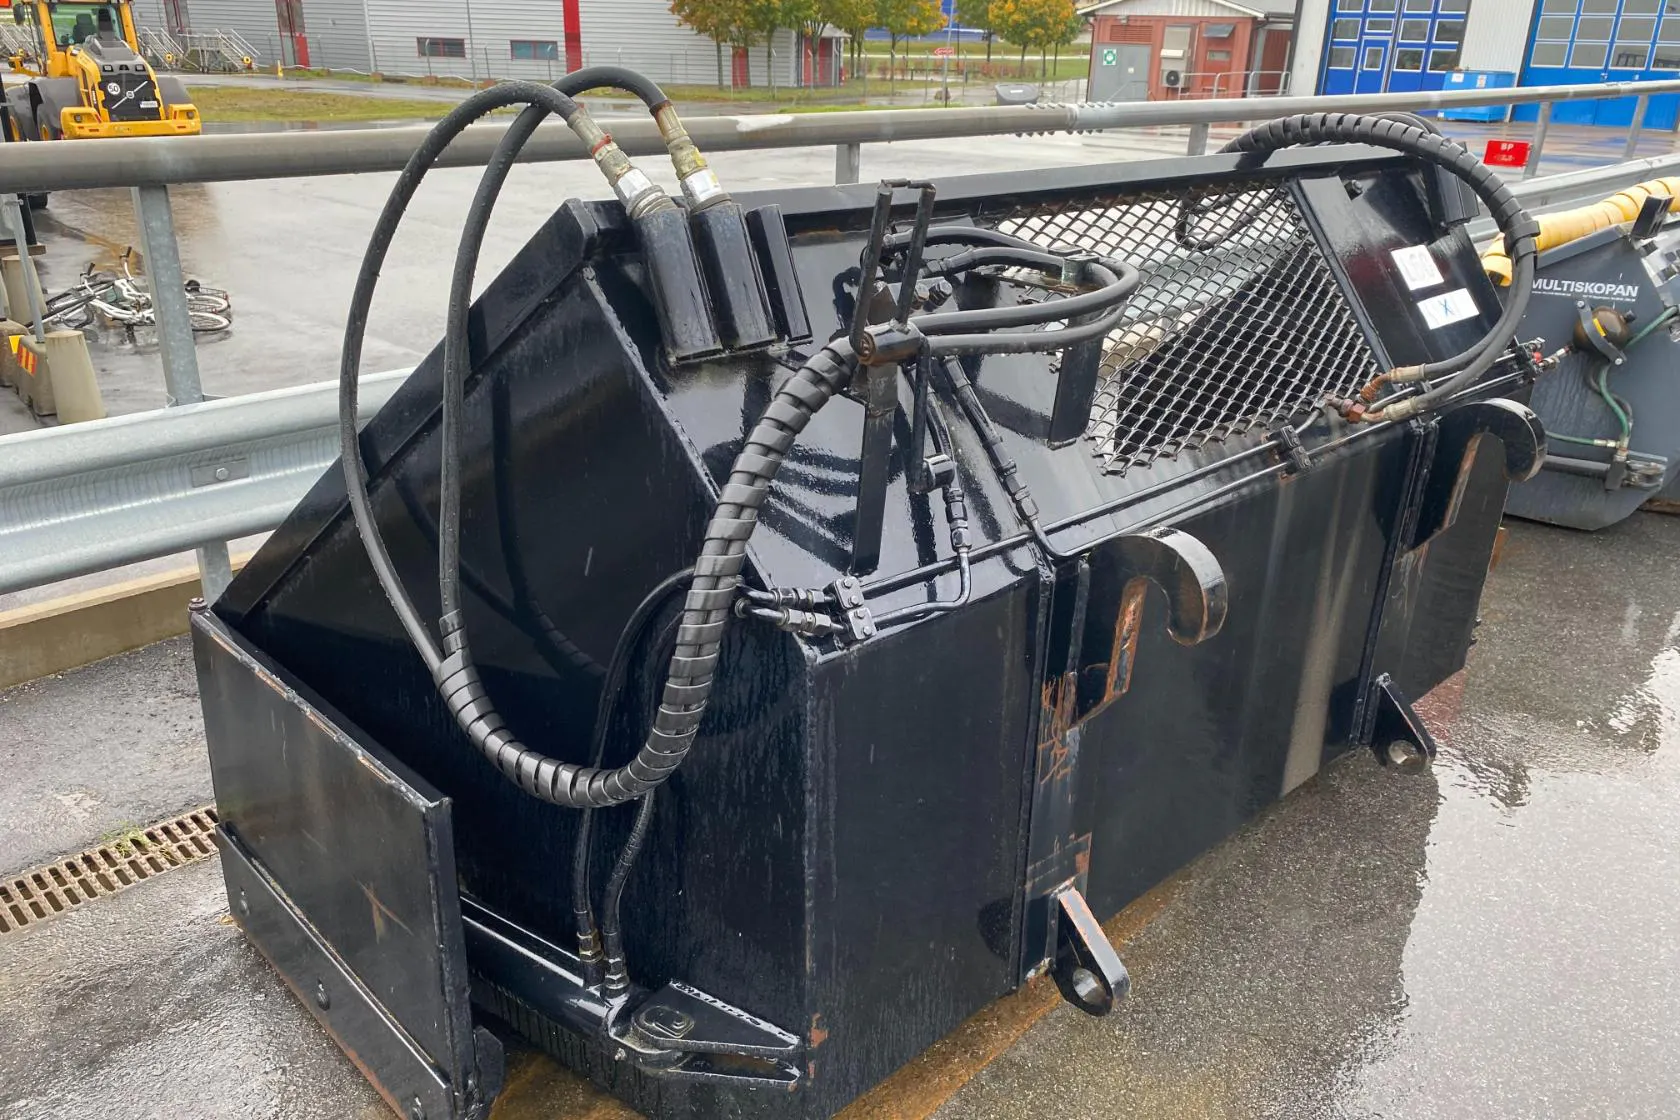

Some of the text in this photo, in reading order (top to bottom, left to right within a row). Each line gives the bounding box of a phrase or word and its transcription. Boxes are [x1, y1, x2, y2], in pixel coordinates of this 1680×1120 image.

[108, 84, 119, 93] 50
[1500, 142, 1515, 152] BP
[1532, 278, 1639, 297] MULTISKOPAN
